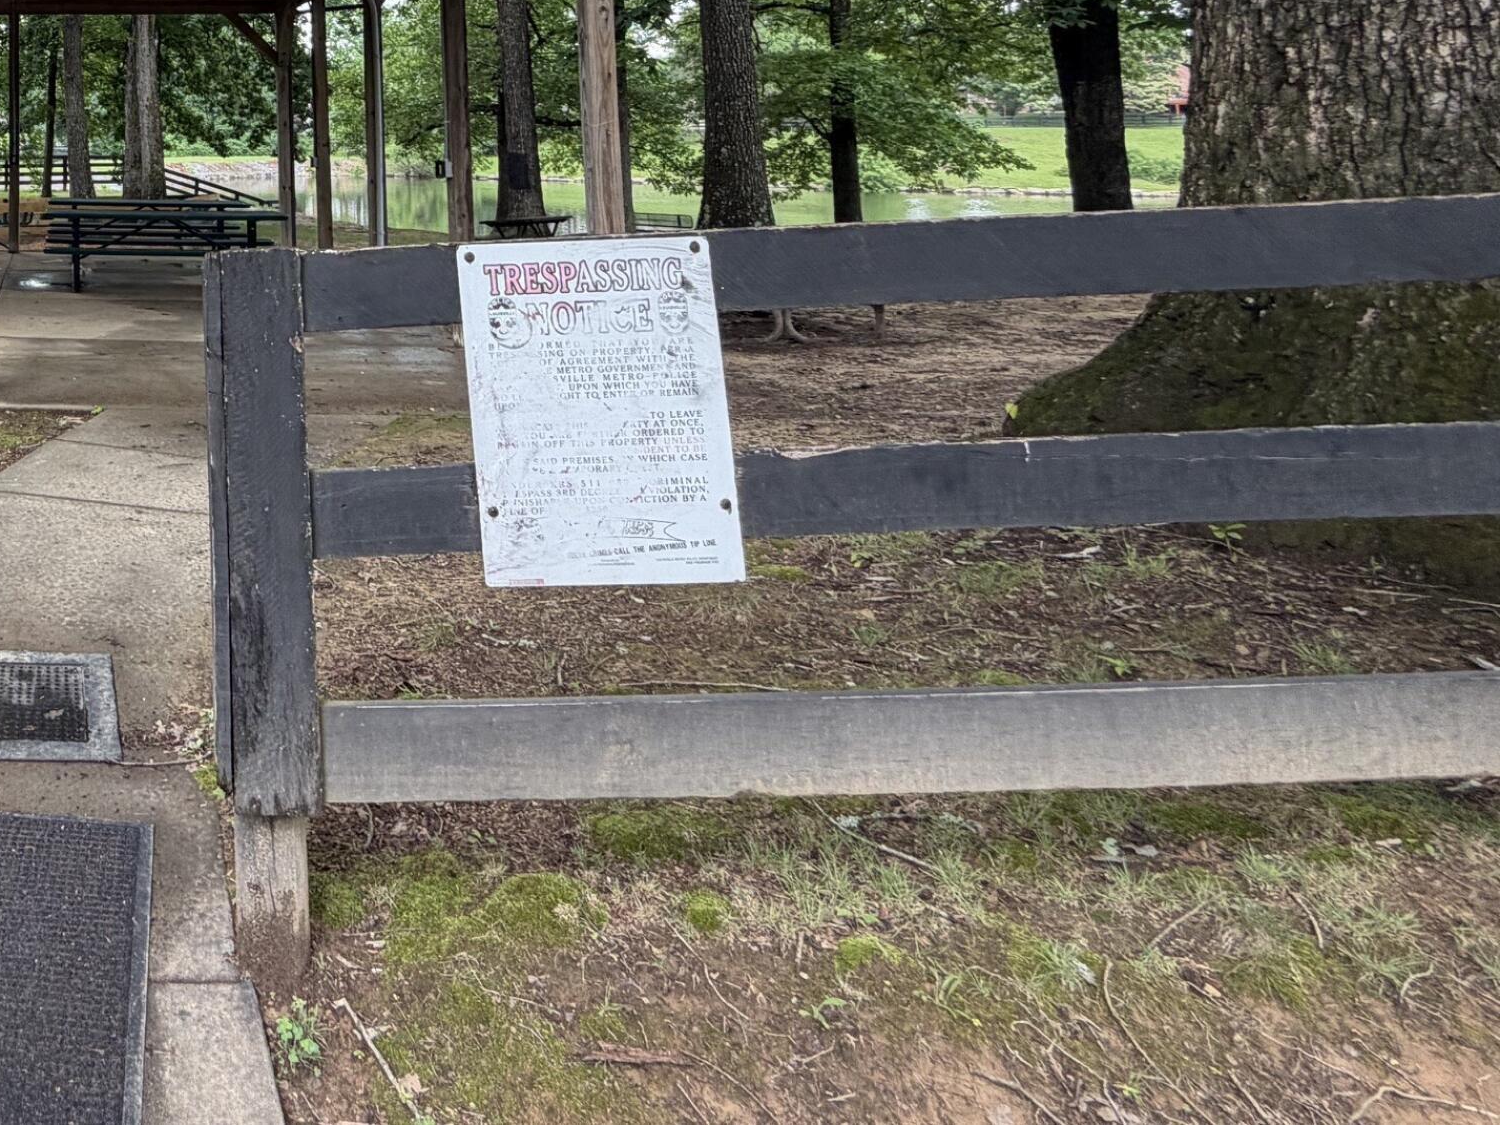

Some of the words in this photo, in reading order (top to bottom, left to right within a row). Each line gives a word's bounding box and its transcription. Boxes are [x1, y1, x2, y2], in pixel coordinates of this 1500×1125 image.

[483, 257, 683, 296] TRESPASSING
[525, 298, 654, 336] NOTICE
[569, 349, 586, 357] ON
[559, 356, 630, 366] AGREEMENT
[556, 365, 593, 375] METRO
[568, 382, 599, 391] UPON
[602, 381, 640, 390] WHICH
[644, 381, 667, 389] YOU
[671, 379, 699, 388] HAVE
[660, 388, 699, 397] REMAIN
[649, 411, 665, 420] TO
[669, 410, 704, 418] LEAVE
[653, 420, 667, 428] AT
[632, 427, 685, 437] ORDERED
[690, 426, 705, 435] TO
[543, 440, 565, 448] OFF
[638, 453, 676, 462] WHICH
[680, 453, 708, 461] CASE
[654, 476, 709, 485] RIMINAL
[682, 494, 696, 503] BY
[699, 494, 707, 502] A
[632, 546, 645, 554] THE
[648, 541, 687, 552] ANONYMOUS
[702, 539, 717, 547] LINE
